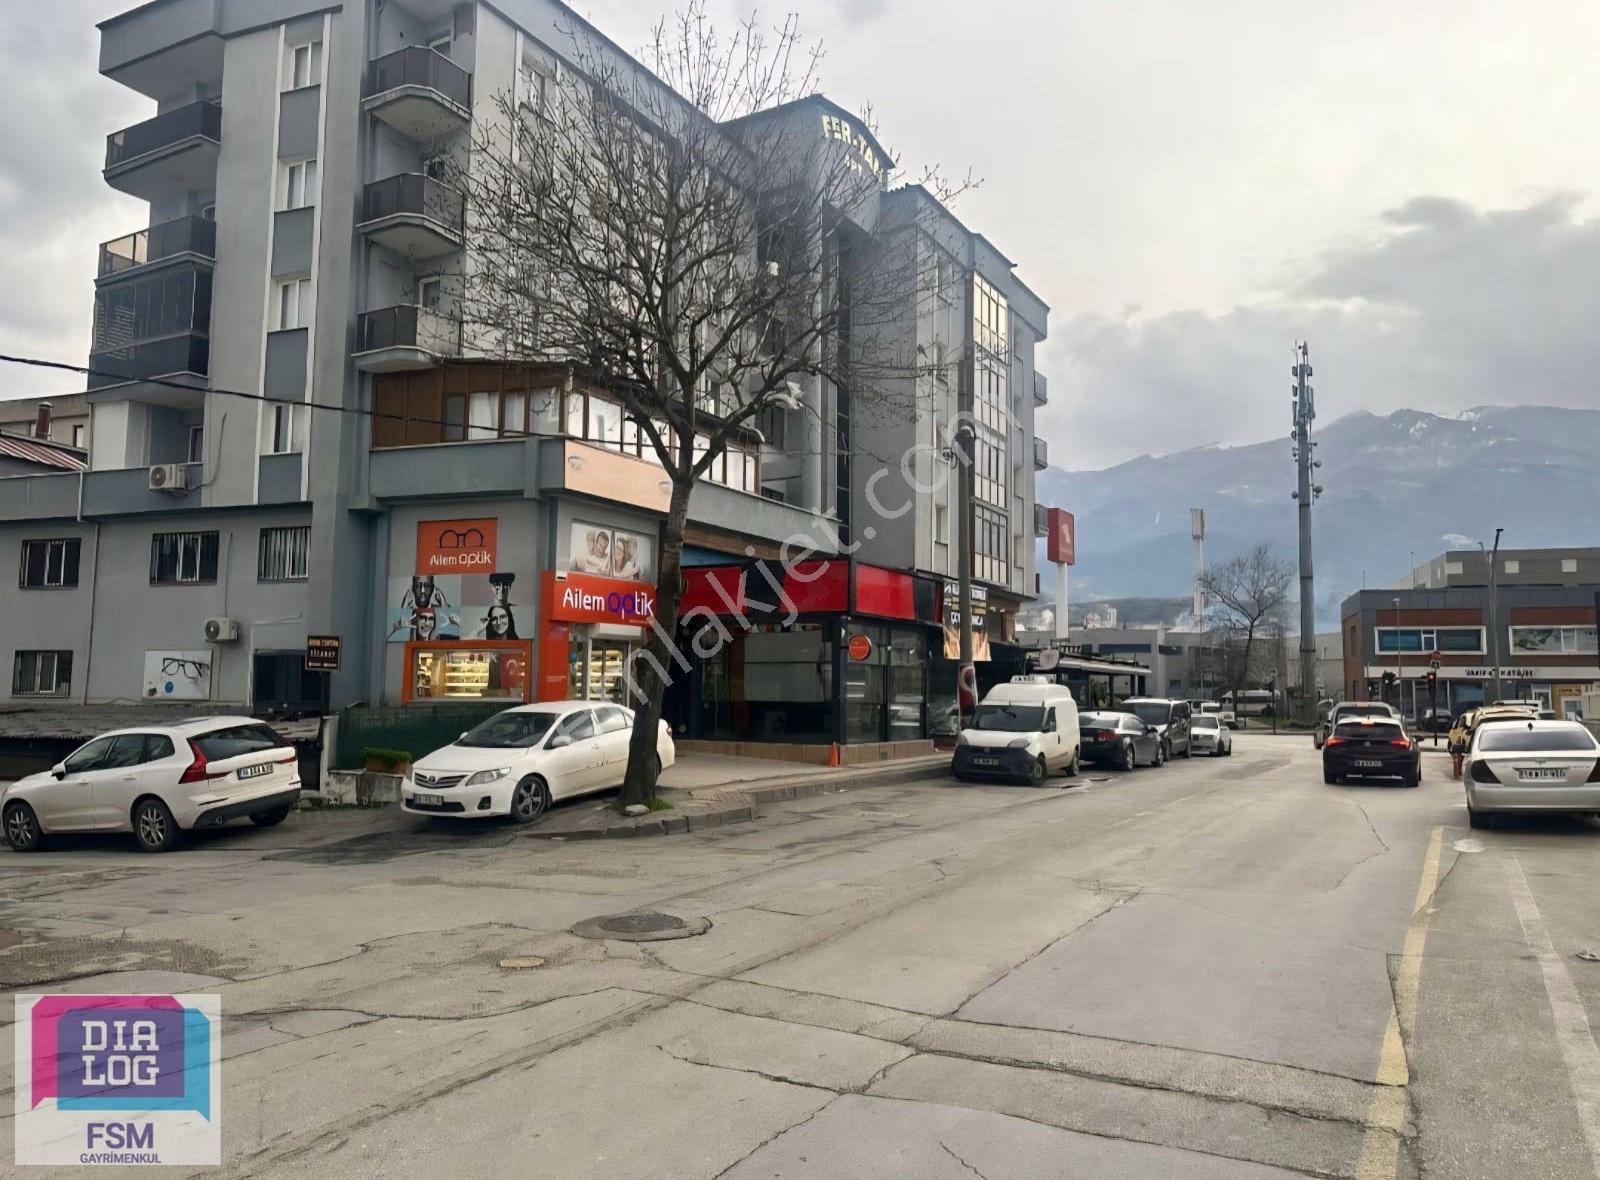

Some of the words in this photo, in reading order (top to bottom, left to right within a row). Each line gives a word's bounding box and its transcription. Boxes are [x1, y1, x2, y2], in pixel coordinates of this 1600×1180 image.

[430, 554, 457, 566] Ailem
[458, 550, 492, 567] optik
[562, 587, 605, 612] Ailem
[607, 590, 655, 620] optik
